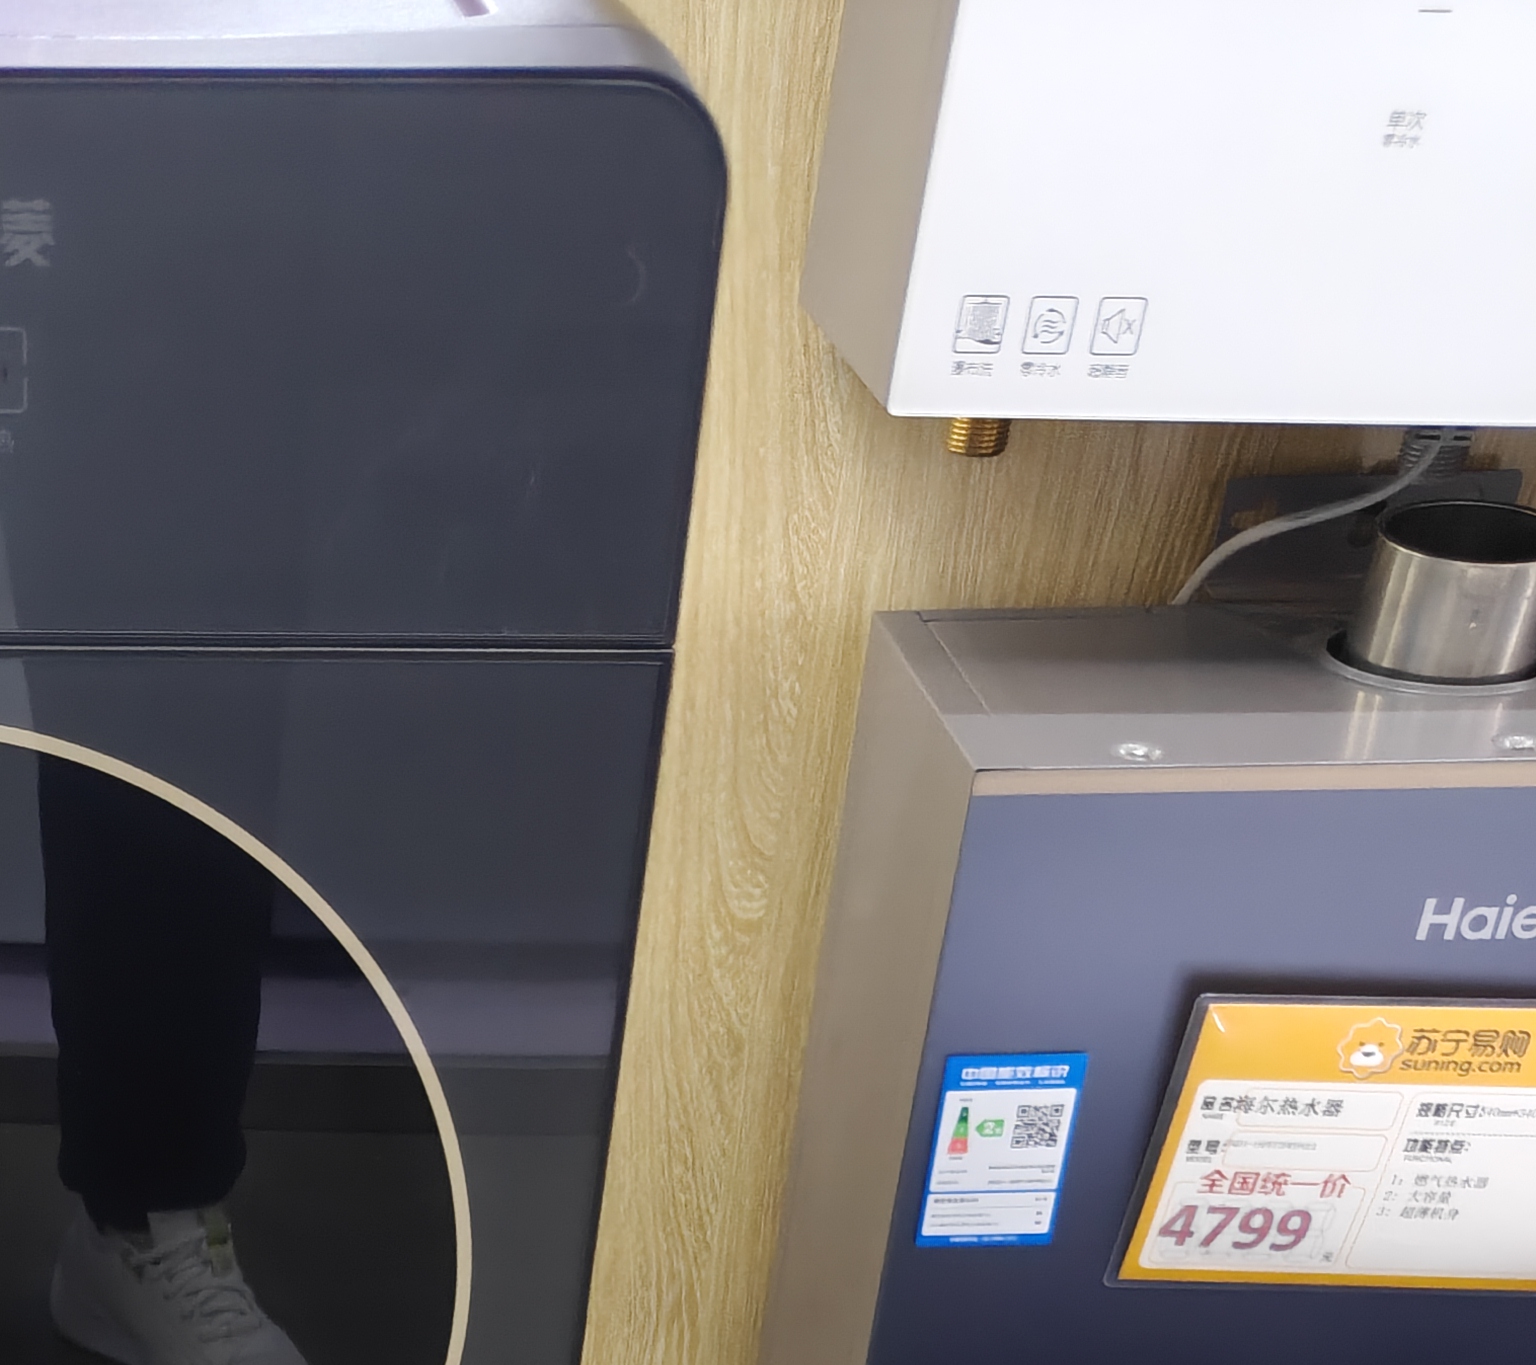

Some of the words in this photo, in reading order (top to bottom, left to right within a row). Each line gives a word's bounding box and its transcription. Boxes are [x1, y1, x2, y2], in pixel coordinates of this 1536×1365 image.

[1406, 1028, 1531, 1058] 苏宁易购
[1399, 1059, 1521, 1077] suning.com
[1197, 1169, 1351, 1199] 全国统一价
[1158, 1204, 1312, 1252] 4799
